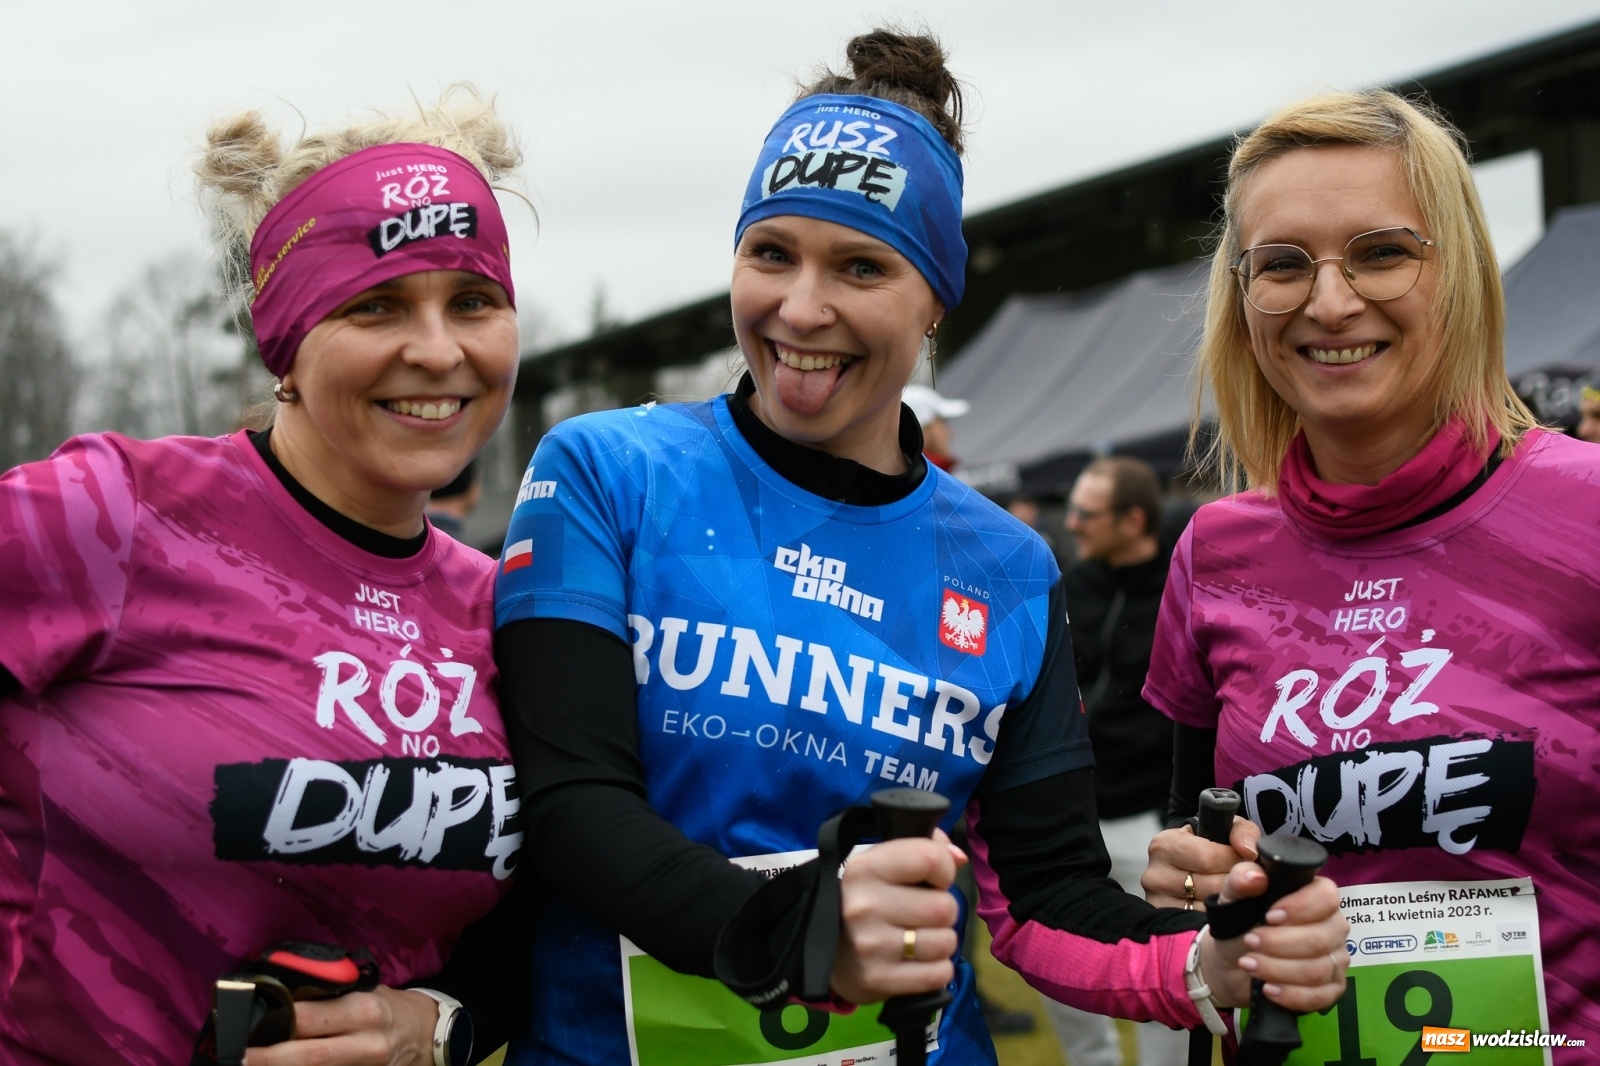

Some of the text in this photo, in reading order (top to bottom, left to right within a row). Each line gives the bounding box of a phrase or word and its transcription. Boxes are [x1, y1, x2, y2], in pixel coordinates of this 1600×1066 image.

[815, 104, 881, 120] just HERO
[782, 120, 898, 155] RUSZ
[376, 164, 447, 181] just HERO
[768, 151, 897, 203] DUPĘ
[381, 171, 451, 209] RÓŻ
[411, 196, 431, 208] NO
[380, 203, 471, 252] DUPĘ
[355, 583, 401, 613] JUST
[792, 575, 884, 622] okna
[943, 575, 990, 599] POLAND
[1344, 578, 1403, 601] JUST
[354, 606, 420, 641] HERO
[1334, 606, 1406, 633] HERO
[312, 643, 483, 746] RÓŻ
[1260, 629, 1453, 747] RÓŻ
[402, 733, 440, 758] NO
[1331, 728, 1371, 751] NO
[863, 750, 940, 793] TEAM
[1244, 739, 1493, 855] DUPĘ
[262, 757, 525, 880] DUPĘ
[1340, 887, 1515, 909] ółmaraton Leśny RAFAMET
[1346, 905, 1493, 924] rska, 1 kwietnia 2023 r.
[1365, 938, 1413, 950] RAFAMET
